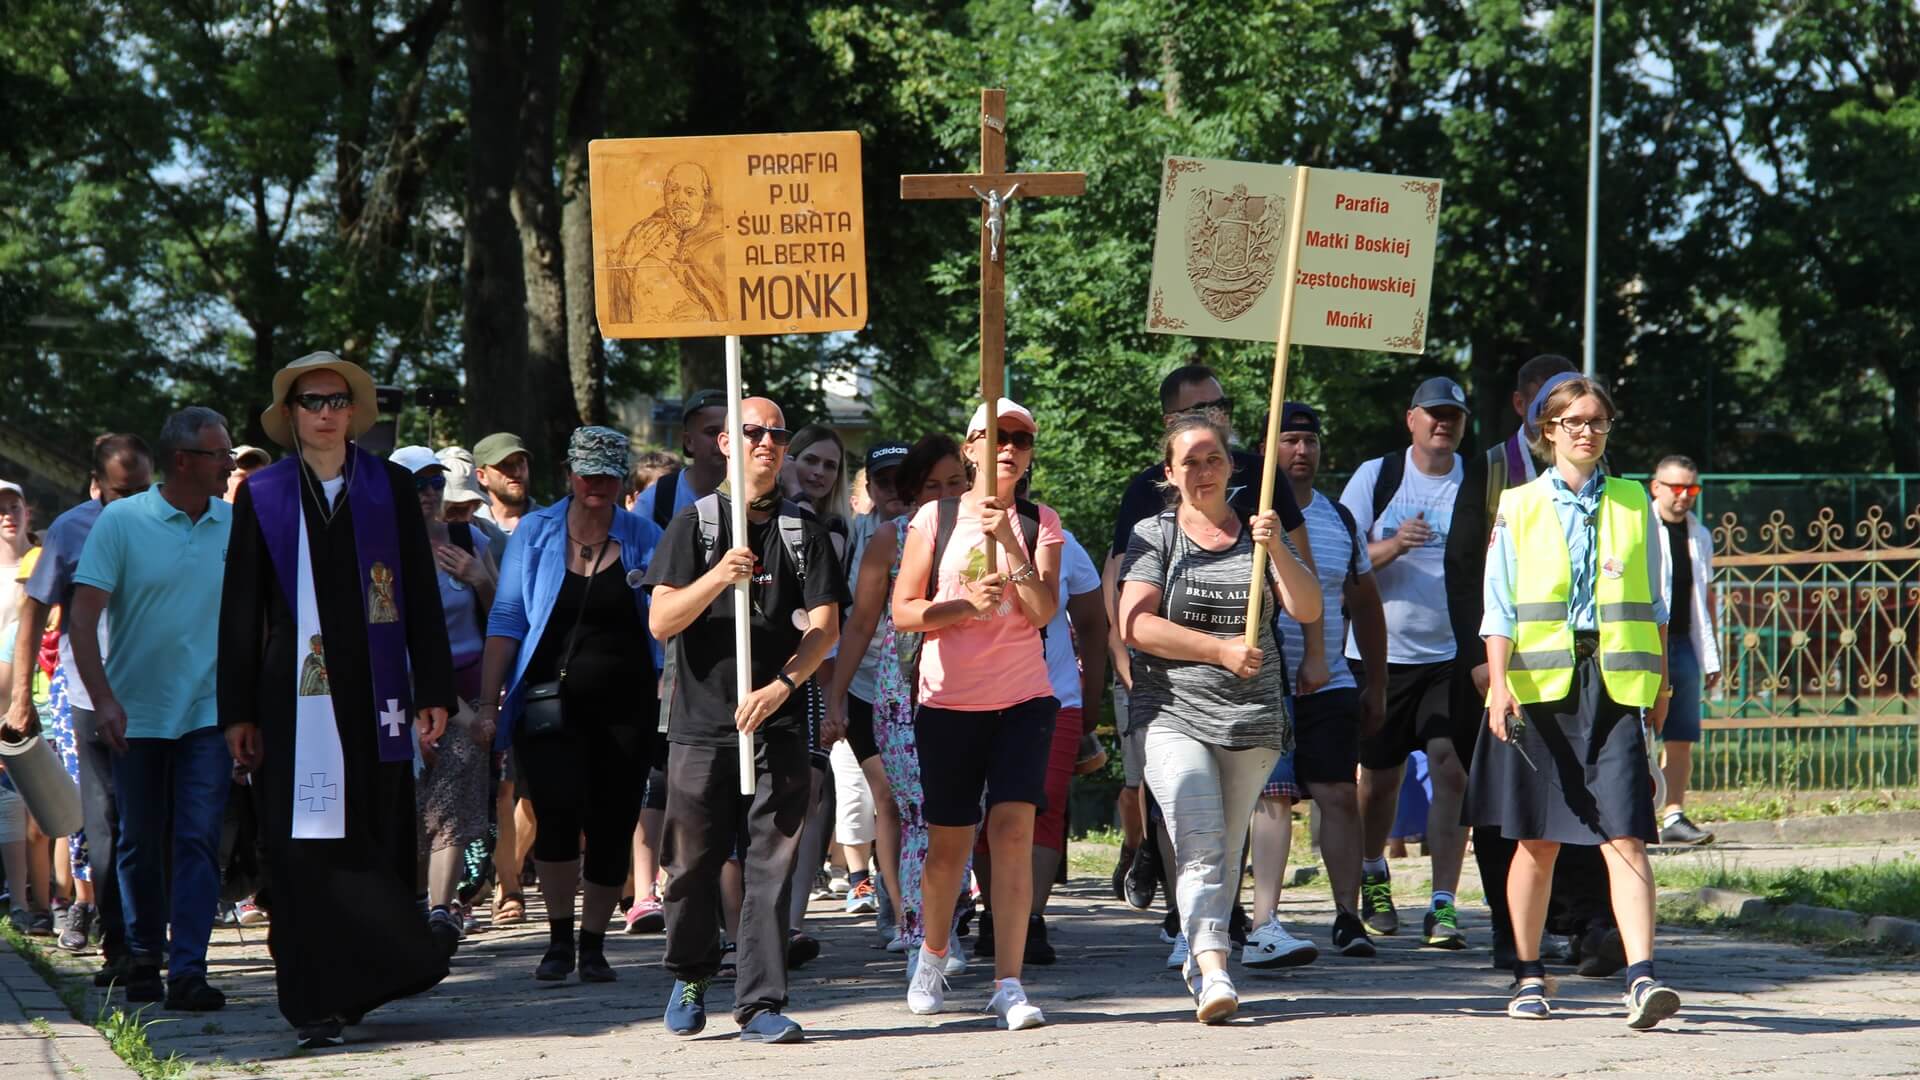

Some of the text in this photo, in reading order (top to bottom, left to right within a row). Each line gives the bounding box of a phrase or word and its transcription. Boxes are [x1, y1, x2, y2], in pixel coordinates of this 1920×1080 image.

[747, 152, 838, 176] PARAFIA
[1335, 193, 1390, 214] Parafia
[737, 210, 852, 236] ŚW. BRATA
[746, 242, 845, 266] ALBERTA
[1305, 230, 1411, 258] Matki Boskiej
[739, 270, 858, 321] MOŃKI
[1326, 310, 1373, 329] Mońki
[872, 446, 909, 458] adidas
[1185, 586, 1250, 600] BREAK ALL
[1183, 610, 1248, 625] THE RULES
